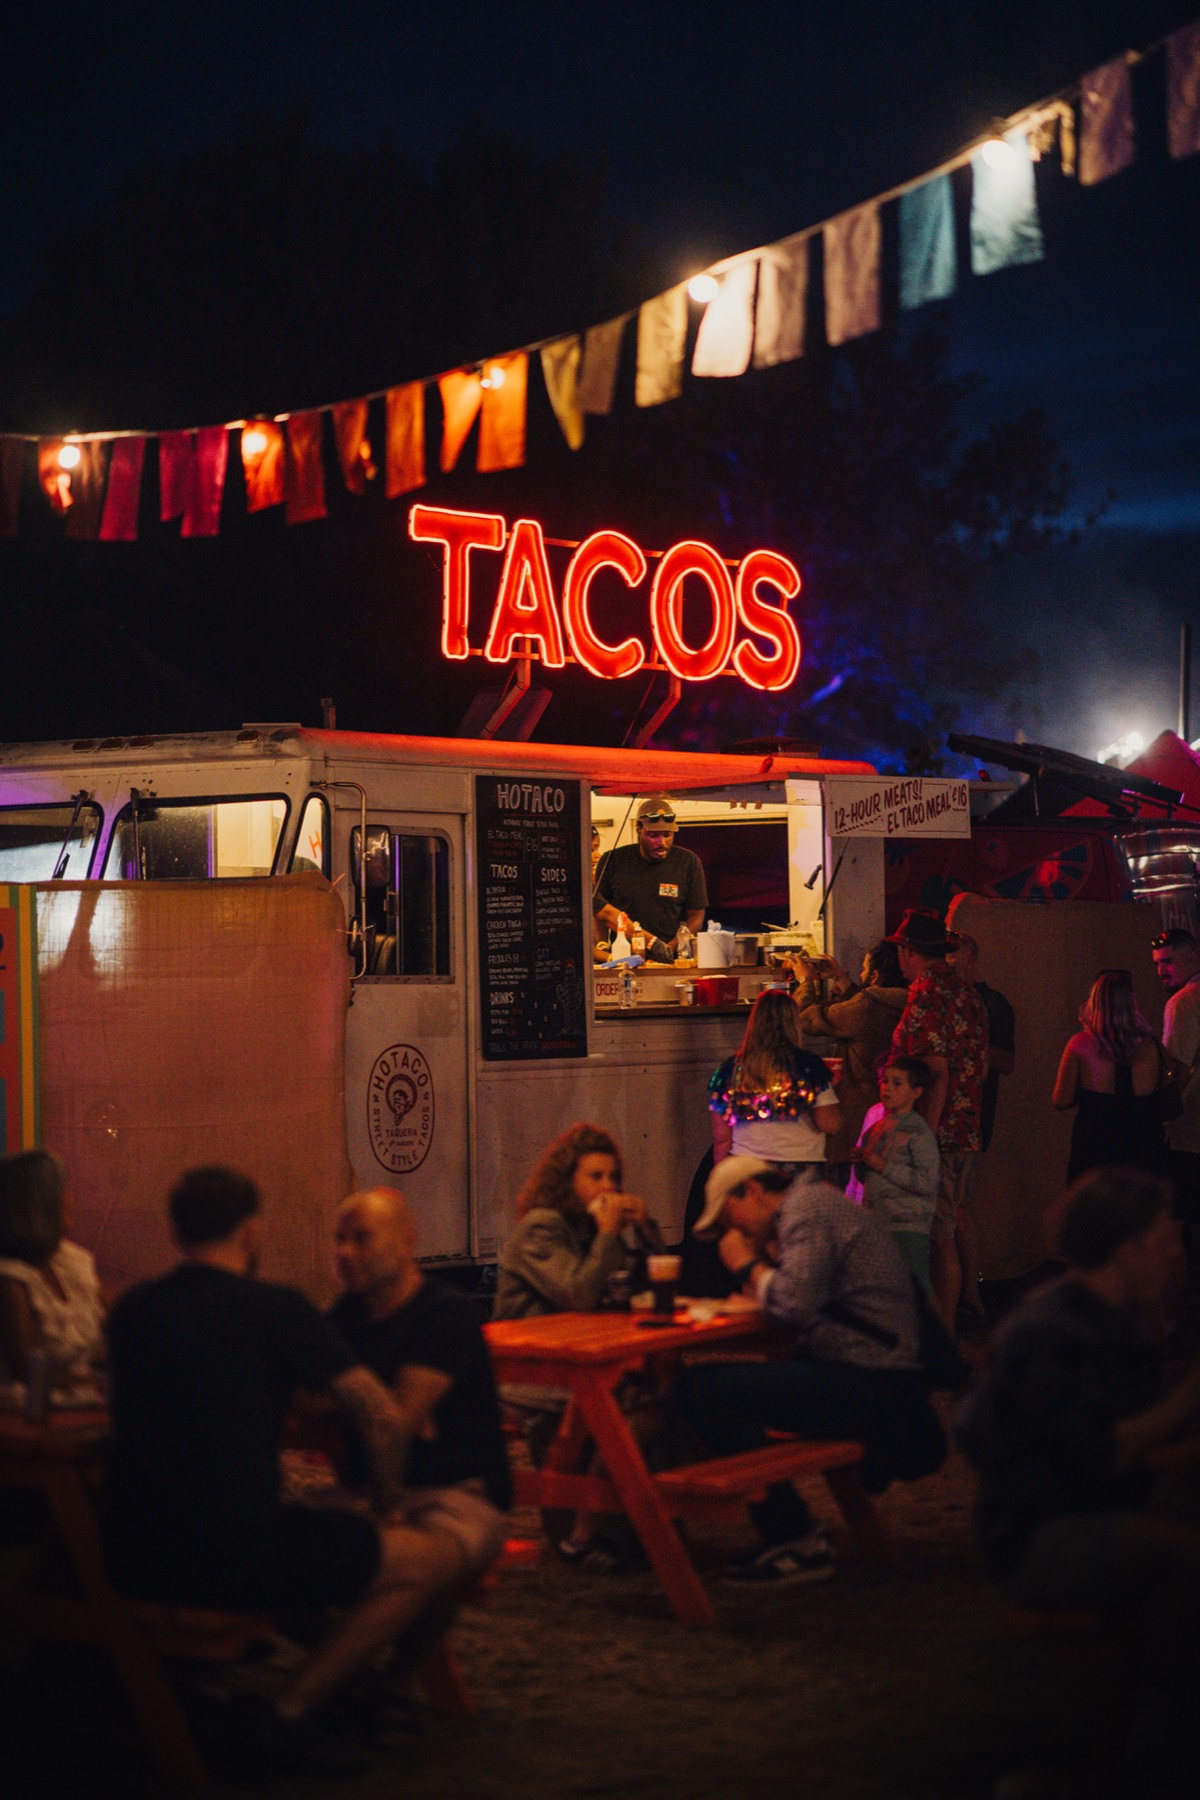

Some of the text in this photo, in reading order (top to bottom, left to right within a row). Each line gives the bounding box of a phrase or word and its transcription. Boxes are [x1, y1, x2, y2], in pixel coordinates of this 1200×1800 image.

[408, 504, 801, 691] TACOS
[497, 783, 565, 812] HOTACO
[834, 778, 923, 830] 12-HOUR MEATS!
[887, 783, 967, 834] EL TACO MEAL £16
[490, 864, 518, 879] TACOS
[541, 867, 567, 882] SIDES
[373, 1051, 429, 1091] HOTACO
[373, 1106, 430, 1165] STREET STYLE TACOS
